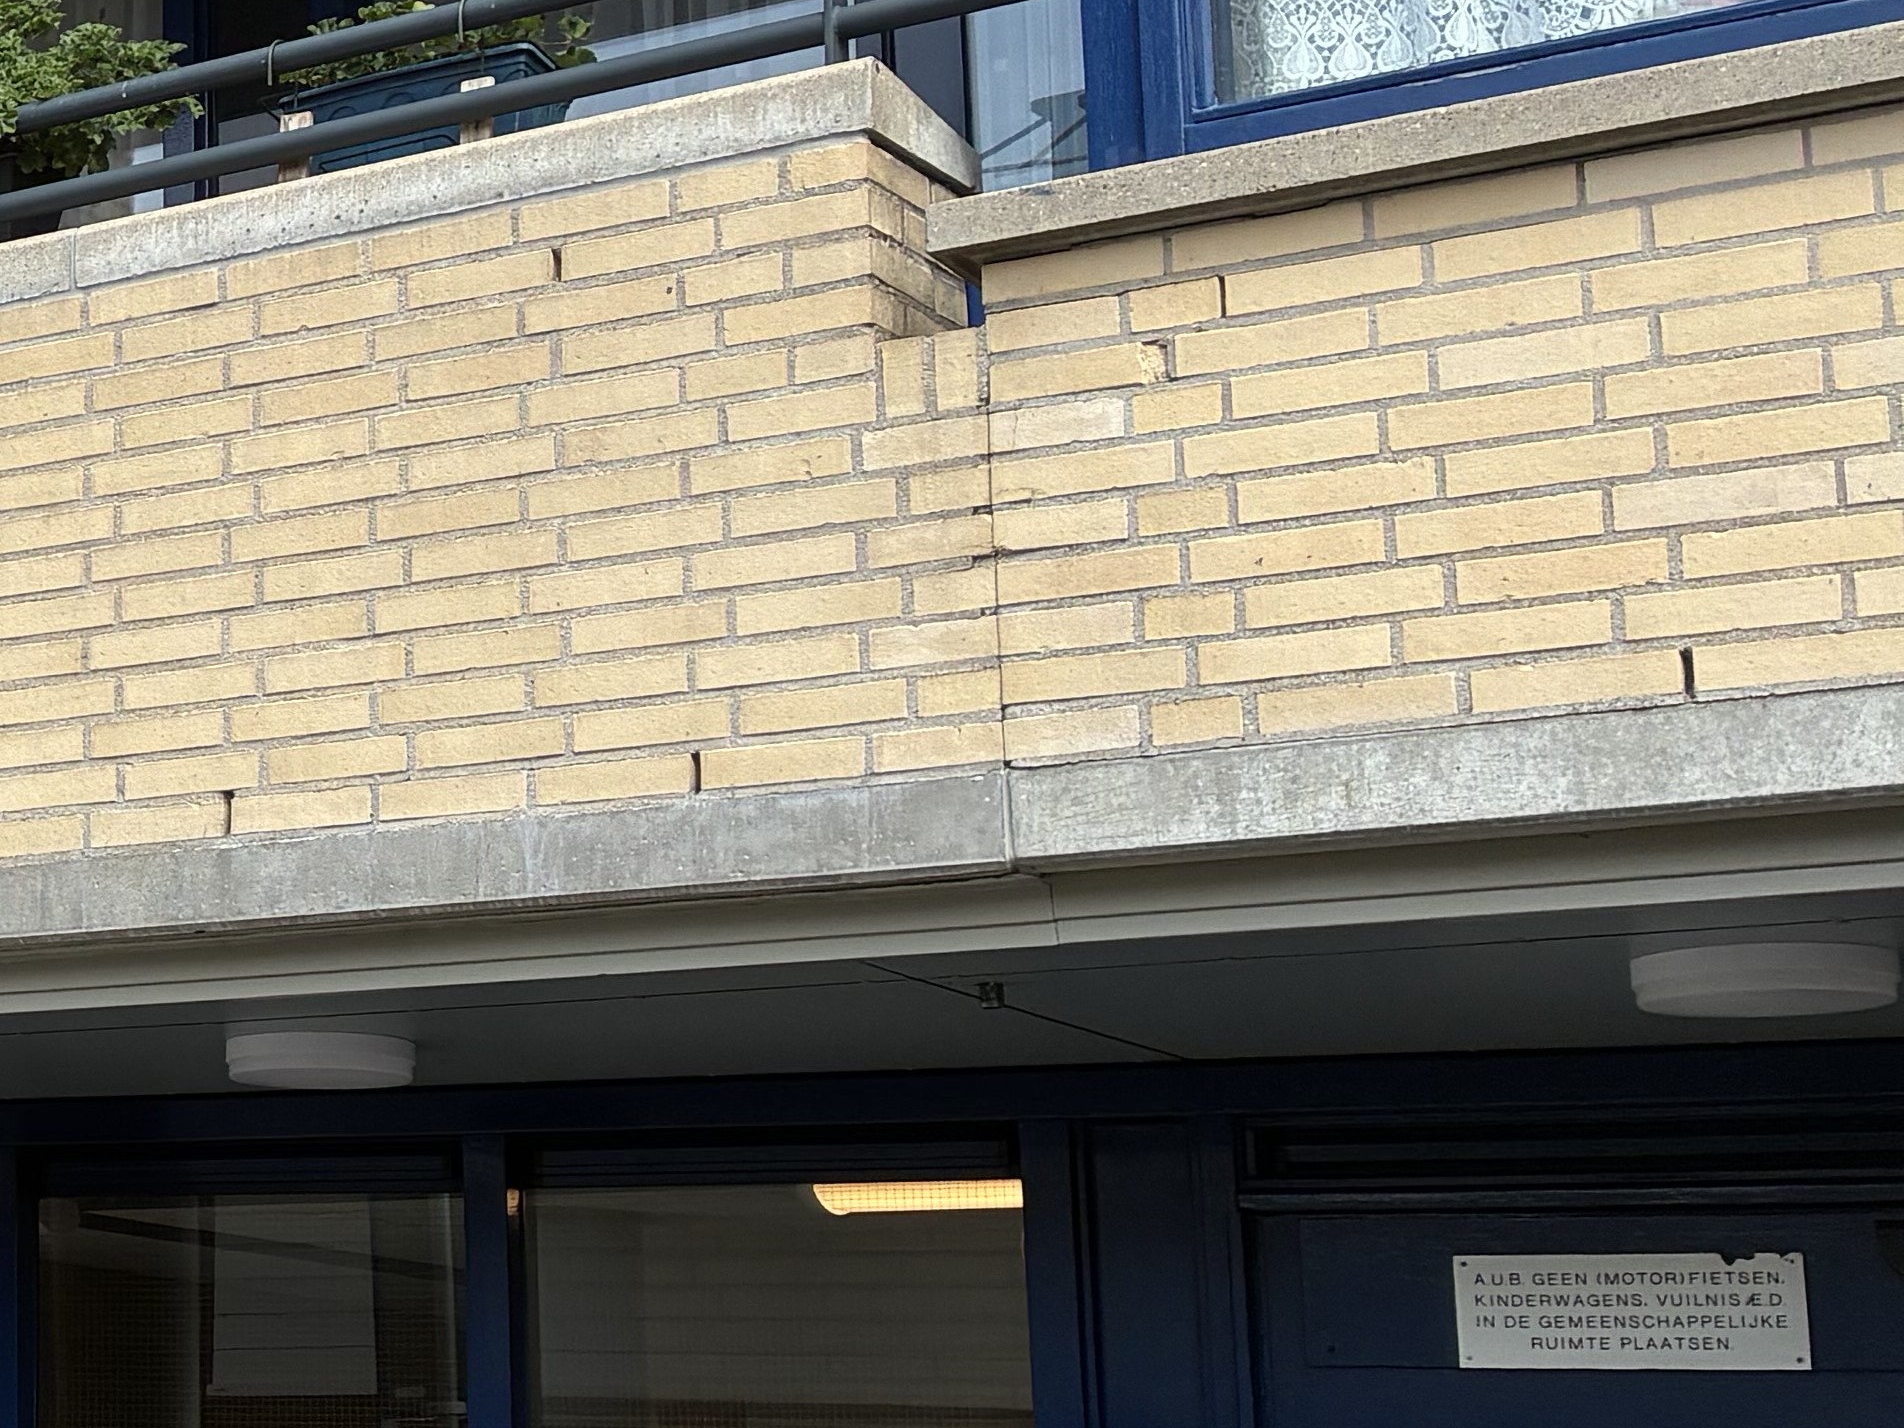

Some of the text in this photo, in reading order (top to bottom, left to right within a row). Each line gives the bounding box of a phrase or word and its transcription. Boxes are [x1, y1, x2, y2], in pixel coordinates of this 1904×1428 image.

[1532, 1272, 1588, 1286] GEEN
[1656, 1293, 1741, 1307] VUILNIS
[1476, 1314, 1788, 1329] IN DE GEMEENSCHAPPELIJKE
[1531, 1336, 1611, 1350] RUIMTE
